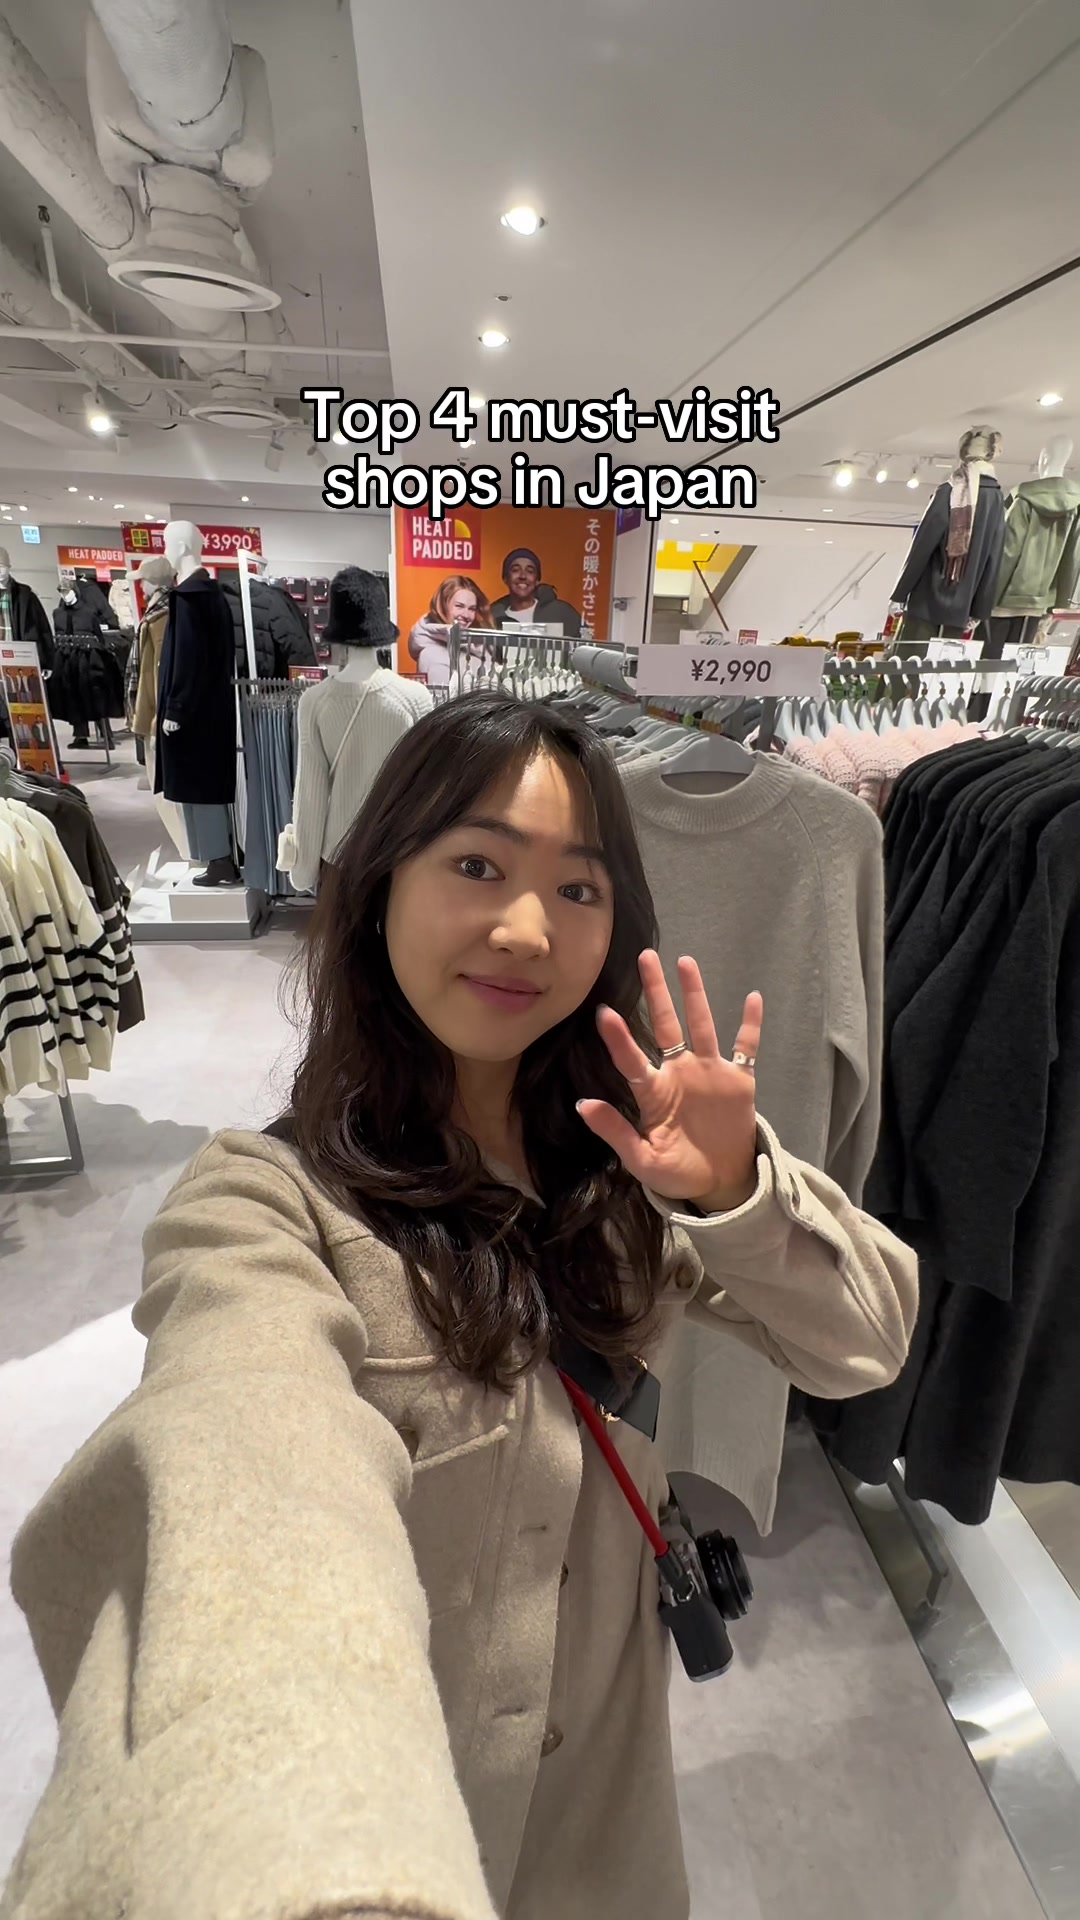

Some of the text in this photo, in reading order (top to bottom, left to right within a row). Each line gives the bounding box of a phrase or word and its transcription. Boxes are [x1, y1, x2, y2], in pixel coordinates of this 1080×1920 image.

[412, 515, 452, 538] HEAT
[68, 548, 124, 562] HEAT PADDED
[412, 538, 473, 561] PADDED
[691, 659, 772, 685] ¥2,990
